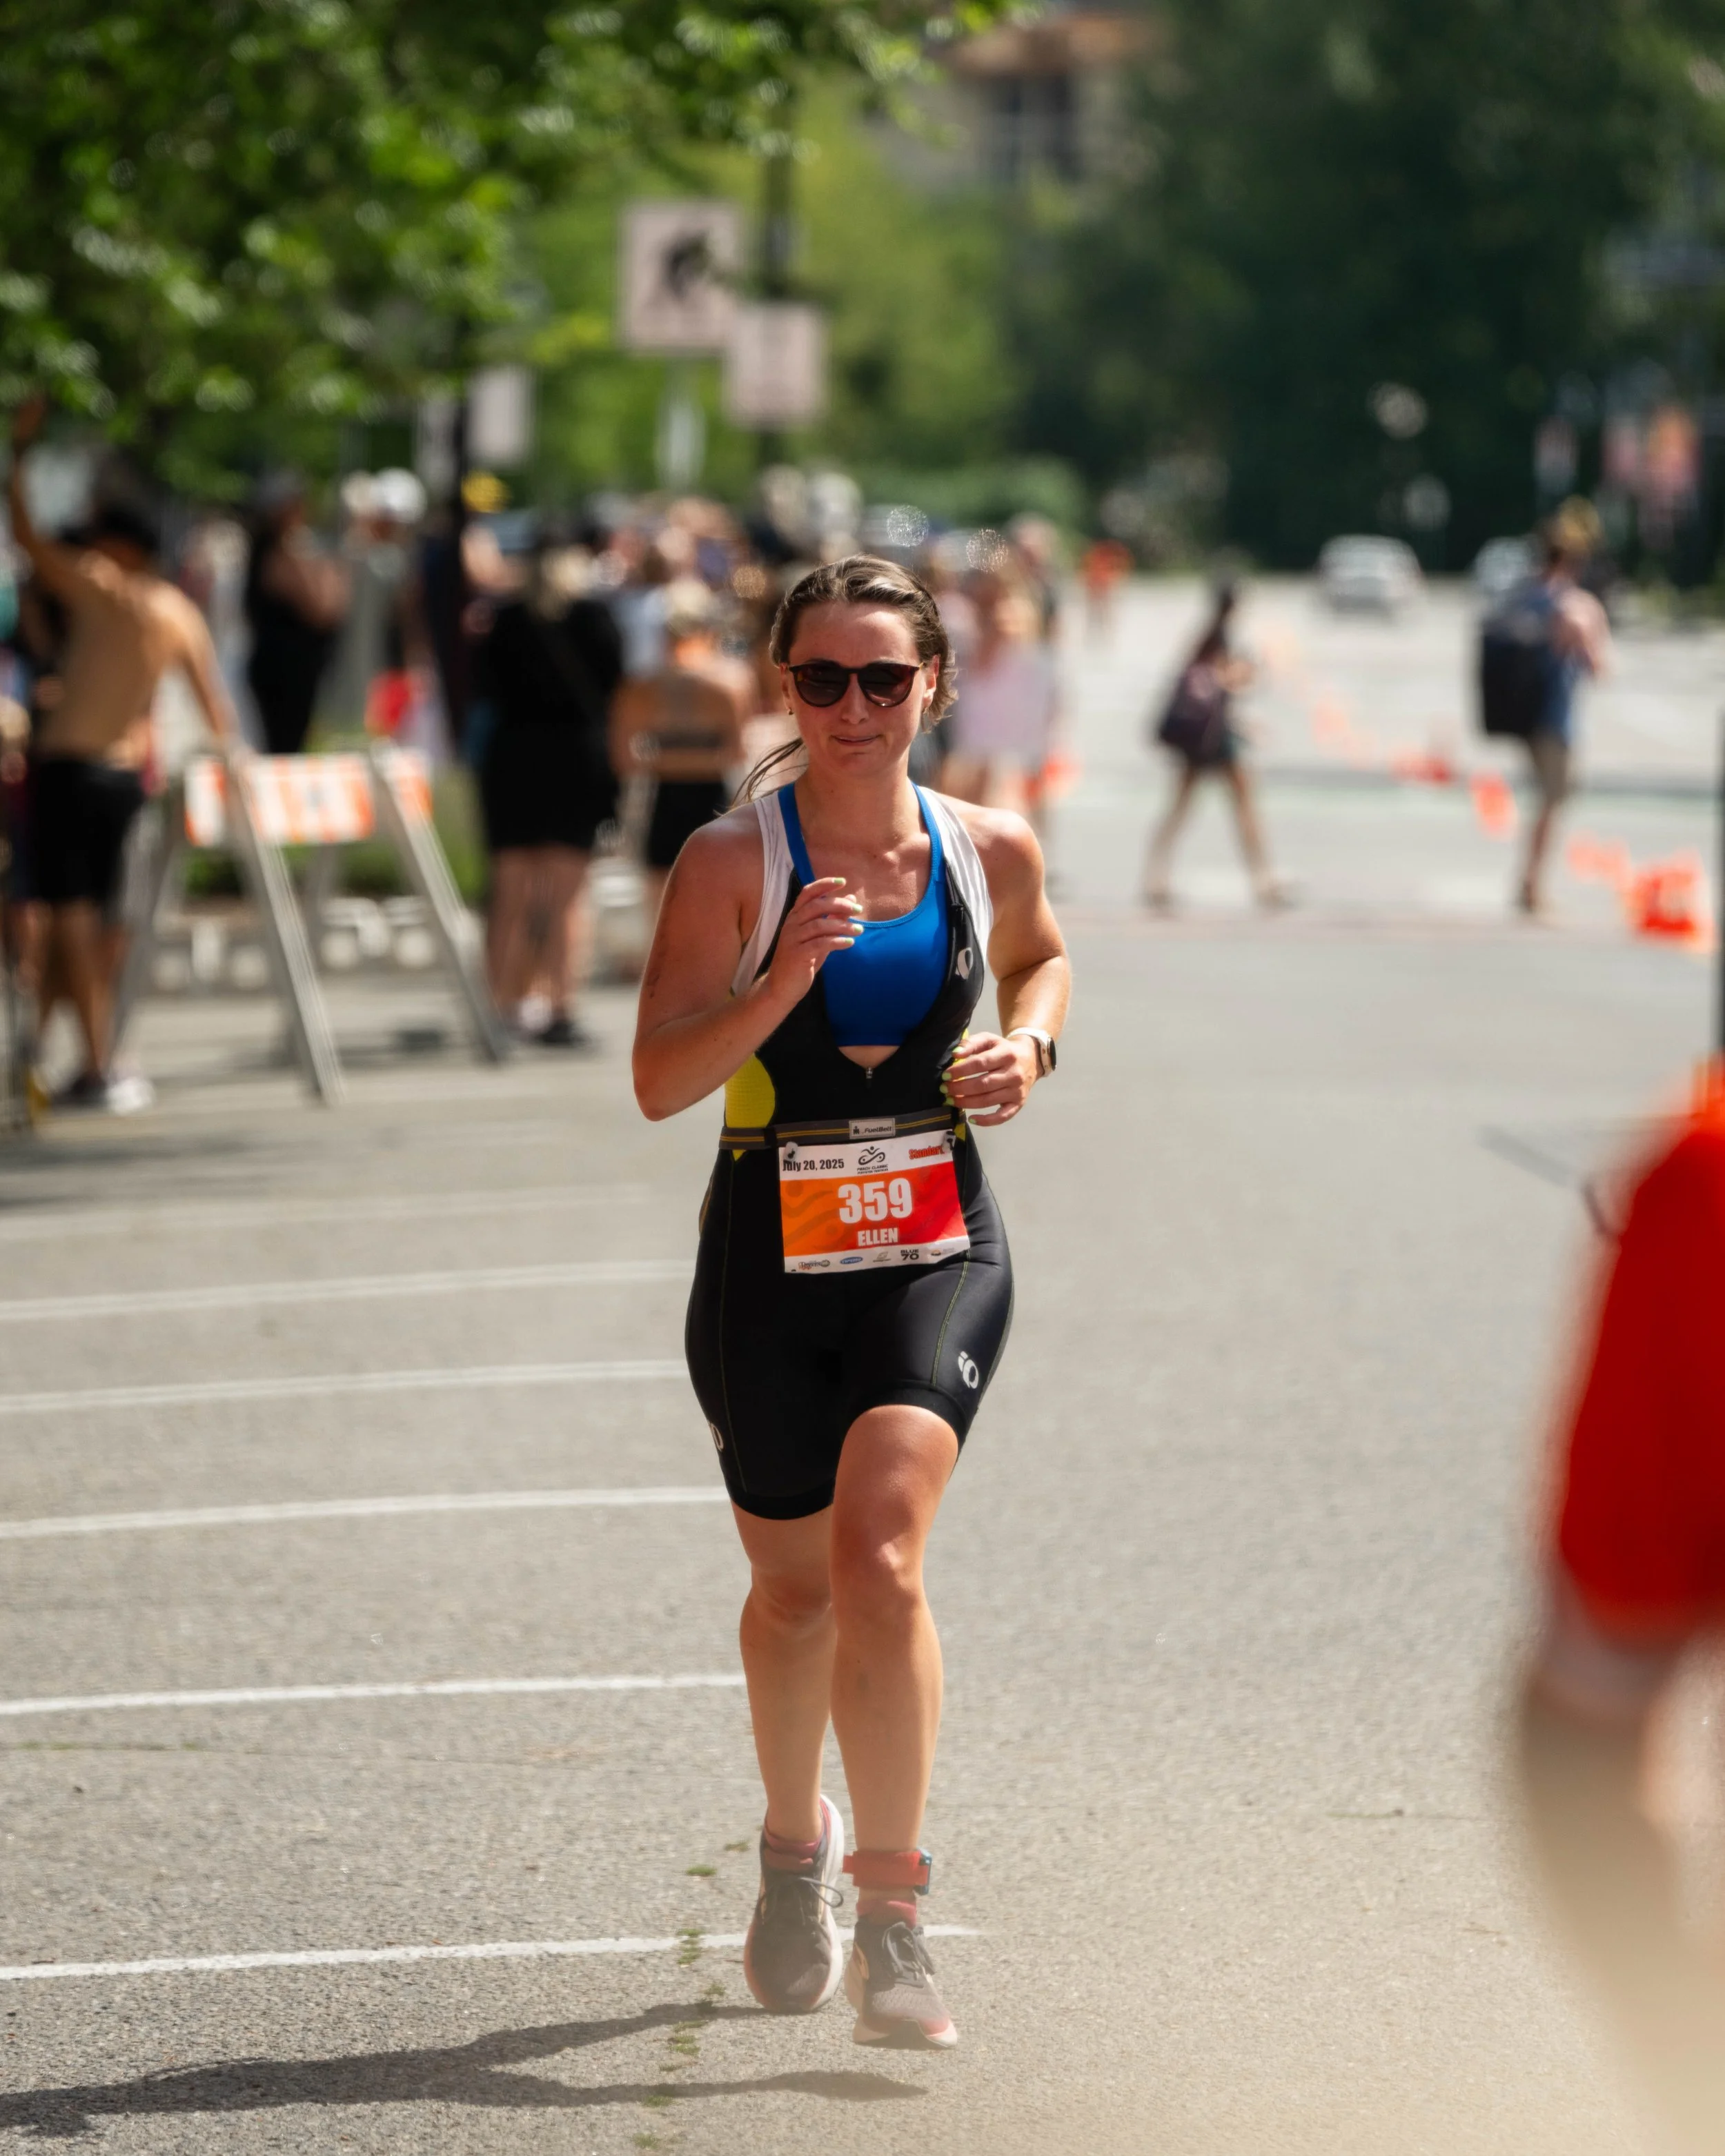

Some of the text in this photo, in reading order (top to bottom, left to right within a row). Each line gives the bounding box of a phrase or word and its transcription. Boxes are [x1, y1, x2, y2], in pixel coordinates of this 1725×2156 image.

[864, 1125, 892, 1134] FuelBelt
[782, 1158, 845, 1172] July 20, 2025
[838, 1178, 913, 1224] 359
[858, 1227, 898, 1247] ELLEN
[901, 1253, 919, 1261] 70
